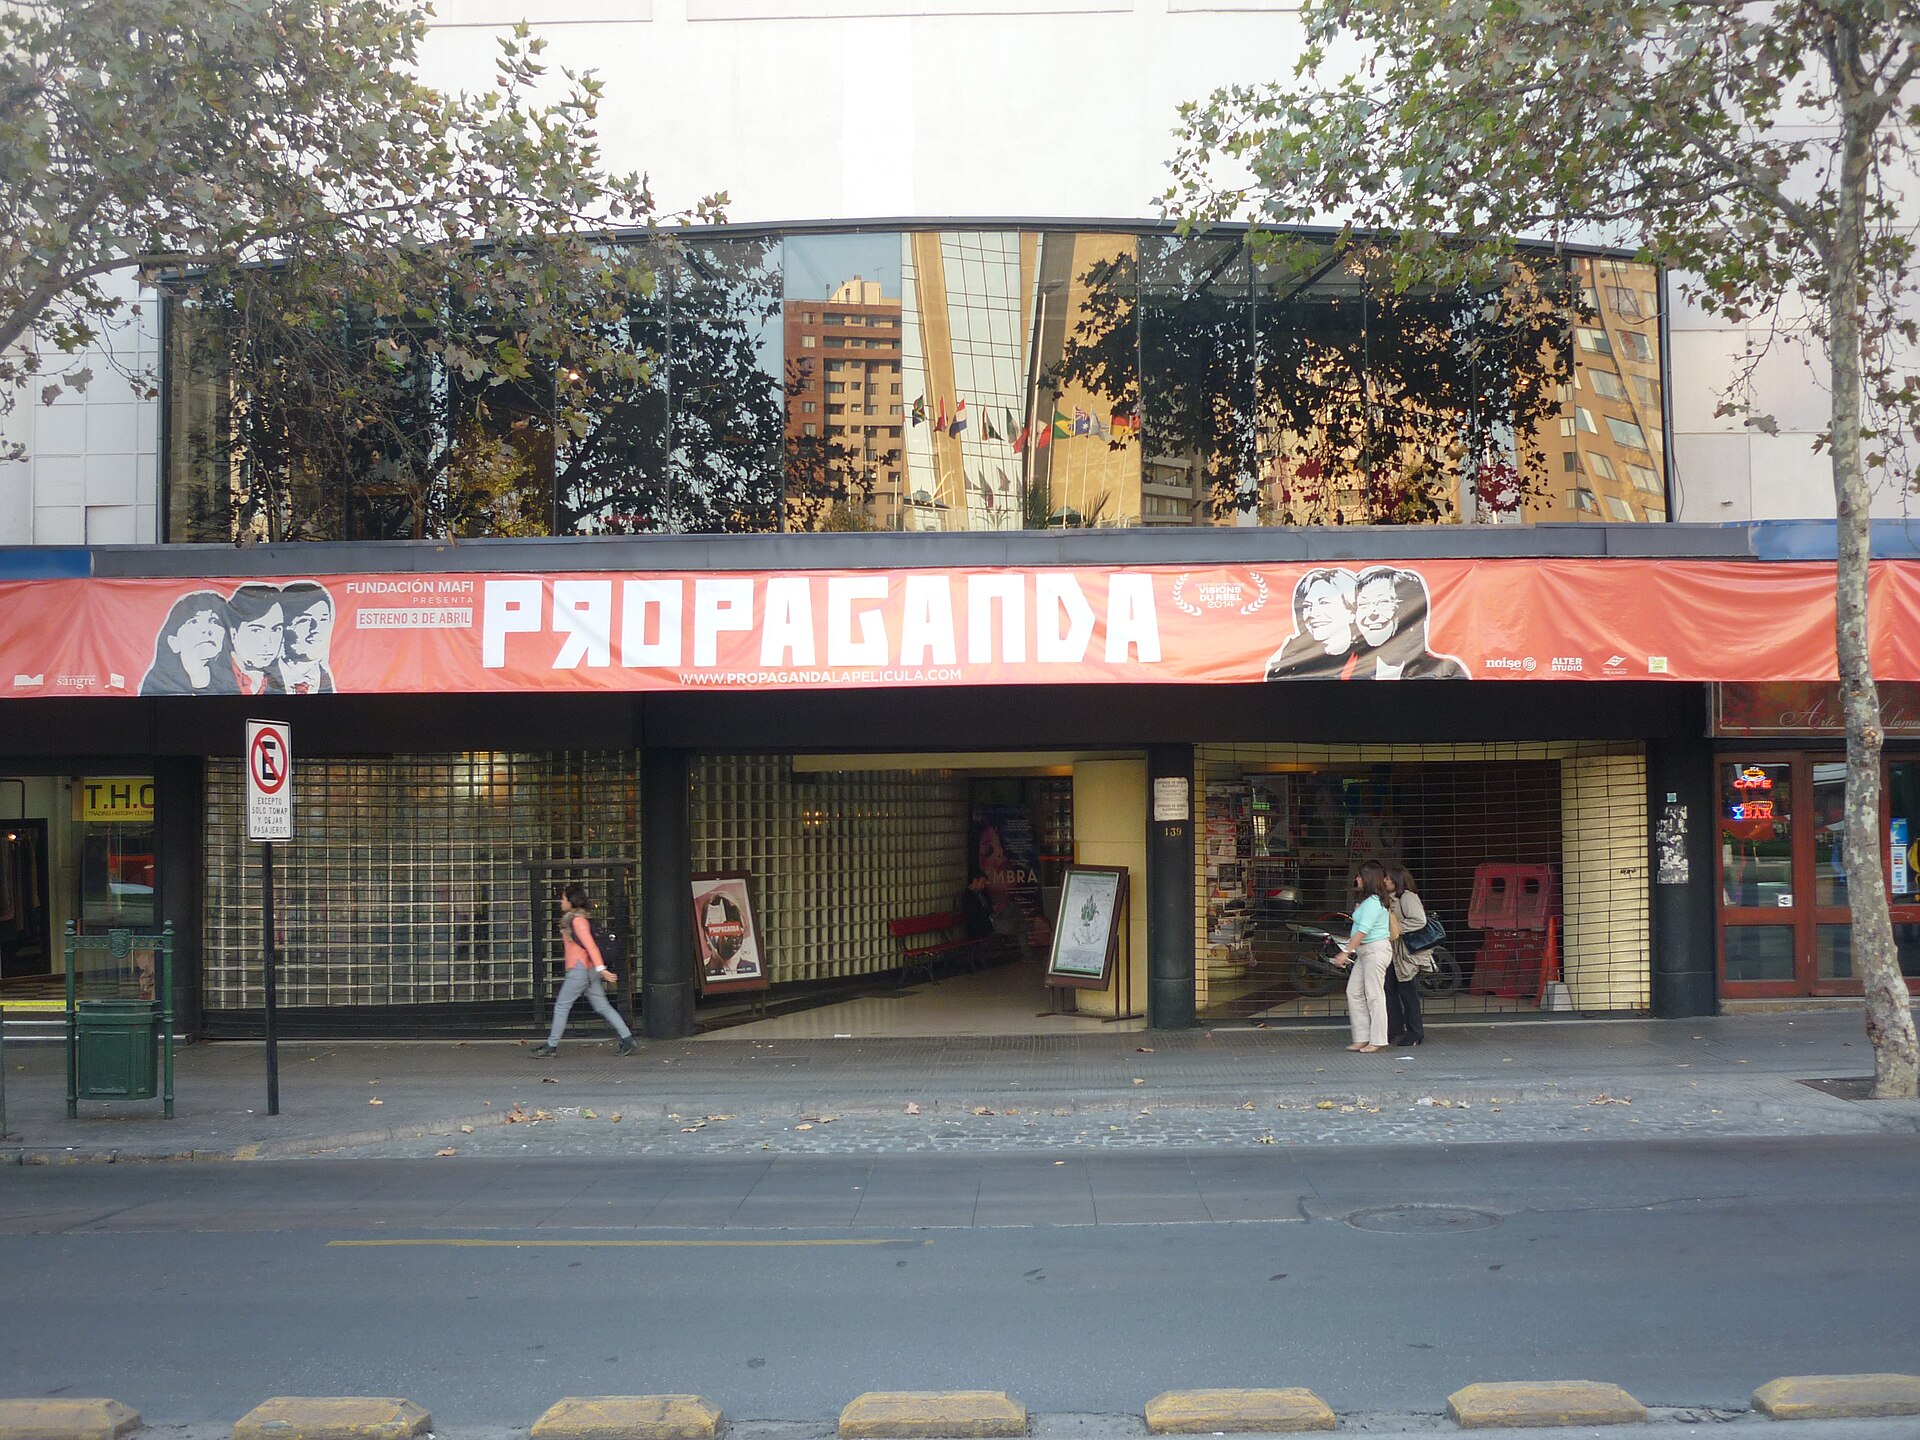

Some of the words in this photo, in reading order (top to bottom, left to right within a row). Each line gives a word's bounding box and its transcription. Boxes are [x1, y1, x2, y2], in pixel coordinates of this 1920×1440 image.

[346, 578, 434, 594] FUNDACIÓN
[438, 581, 474, 593] MAFI
[1199, 586, 1241, 594] VISIONS
[360, 613, 408, 625] ESTRENO
[412, 612, 418, 624] 3
[422, 612, 436, 624] DE
[439, 612, 470, 623] ABRIL
[1485, 657, 1521, 669] noise
[1551, 664, 1583, 672] STUDIO
[56, 676, 96, 689] sangre
[678, 668, 962, 686] WWW.PROPAGANDALAPELICULA.COM
[1780, 698, 1837, 727] Arte
[257, 797, 283, 806] EXCEPTO
[252, 807, 266, 815] SOLO
[1744, 808, 1773, 819] BAR
[254, 826, 287, 834] PASAJEROS
[1165, 827, 1182, 837] 139
